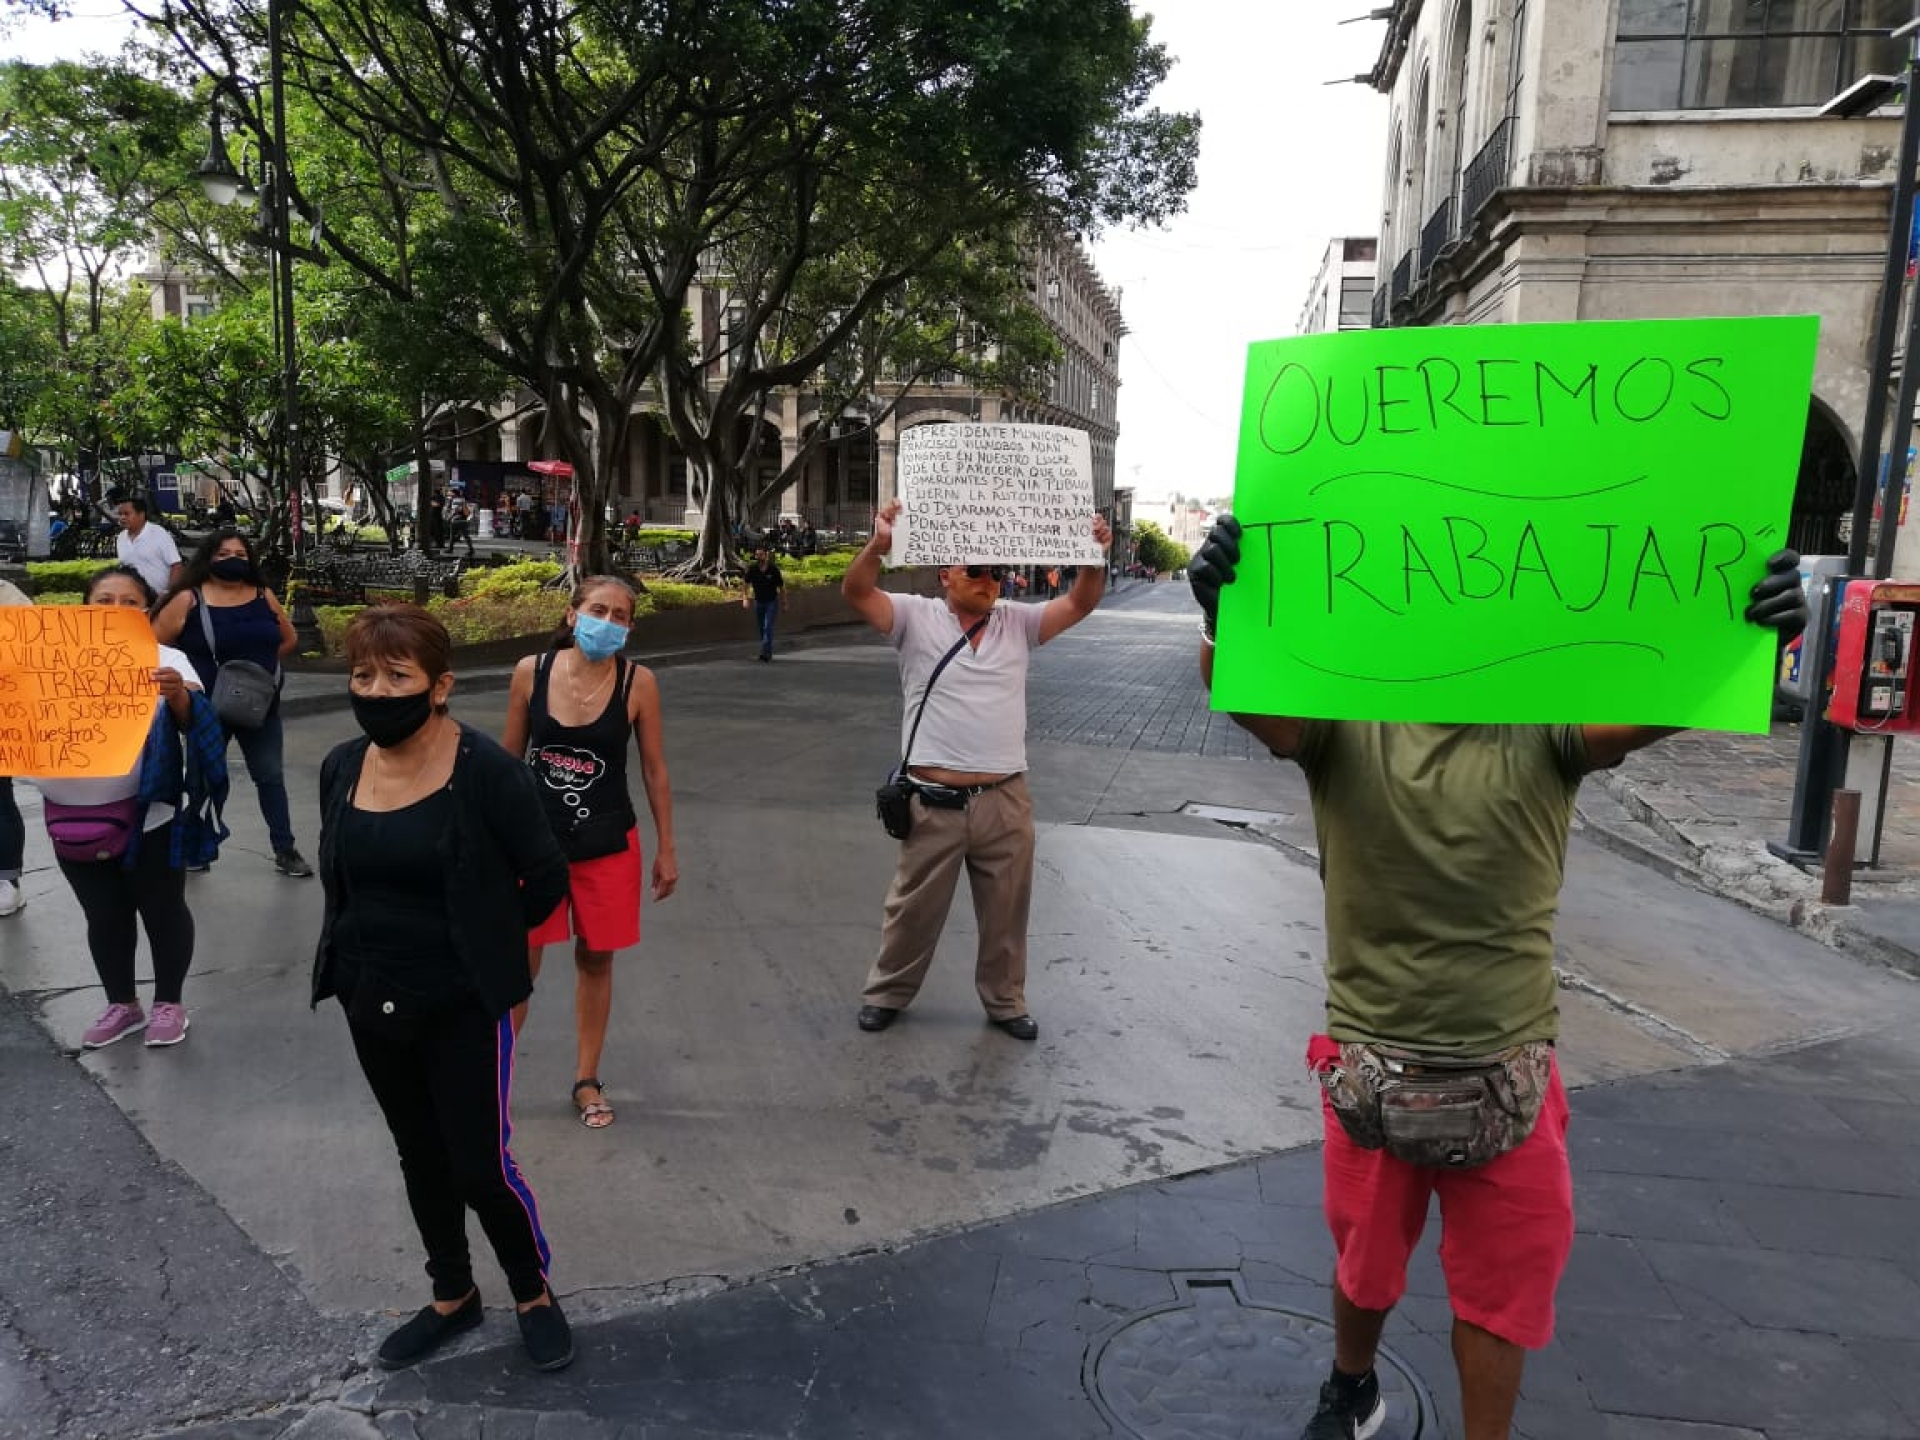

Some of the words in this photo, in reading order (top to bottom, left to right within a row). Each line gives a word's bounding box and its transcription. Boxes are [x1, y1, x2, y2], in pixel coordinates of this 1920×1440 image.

[920, 425, 1007, 440] PRESIDENTE
[1012, 427, 1078, 447] MUNICIPAL
[978, 452, 1029, 466] NUESTRO
[903, 461, 928, 476] QUE
[932, 461, 950, 474] LE
[956, 462, 1024, 478] PARECERIA
[1029, 466, 1055, 478] QUE
[993, 476, 1014, 490] DE
[1018, 479, 1041, 491] VIA
[969, 489, 986, 501] LA
[992, 490, 1065, 506] AUTORIDAD
[907, 501, 930, 514] LO
[933, 501, 1016, 519] DEJARAMOS
[1018, 506, 1093, 521] TRABAJAR
[906, 514, 979, 532] PONGASE
[1068, 522, 1091, 537] NO
[953, 532, 971, 544] EN
[978, 534, 1025, 548] USTED
[904, 551, 967, 565] ESENCIAL
[907, 542, 926, 552] EN
[992, 546, 1018, 558] QUE
[9, 645, 134, 670] VILLALOBOS
